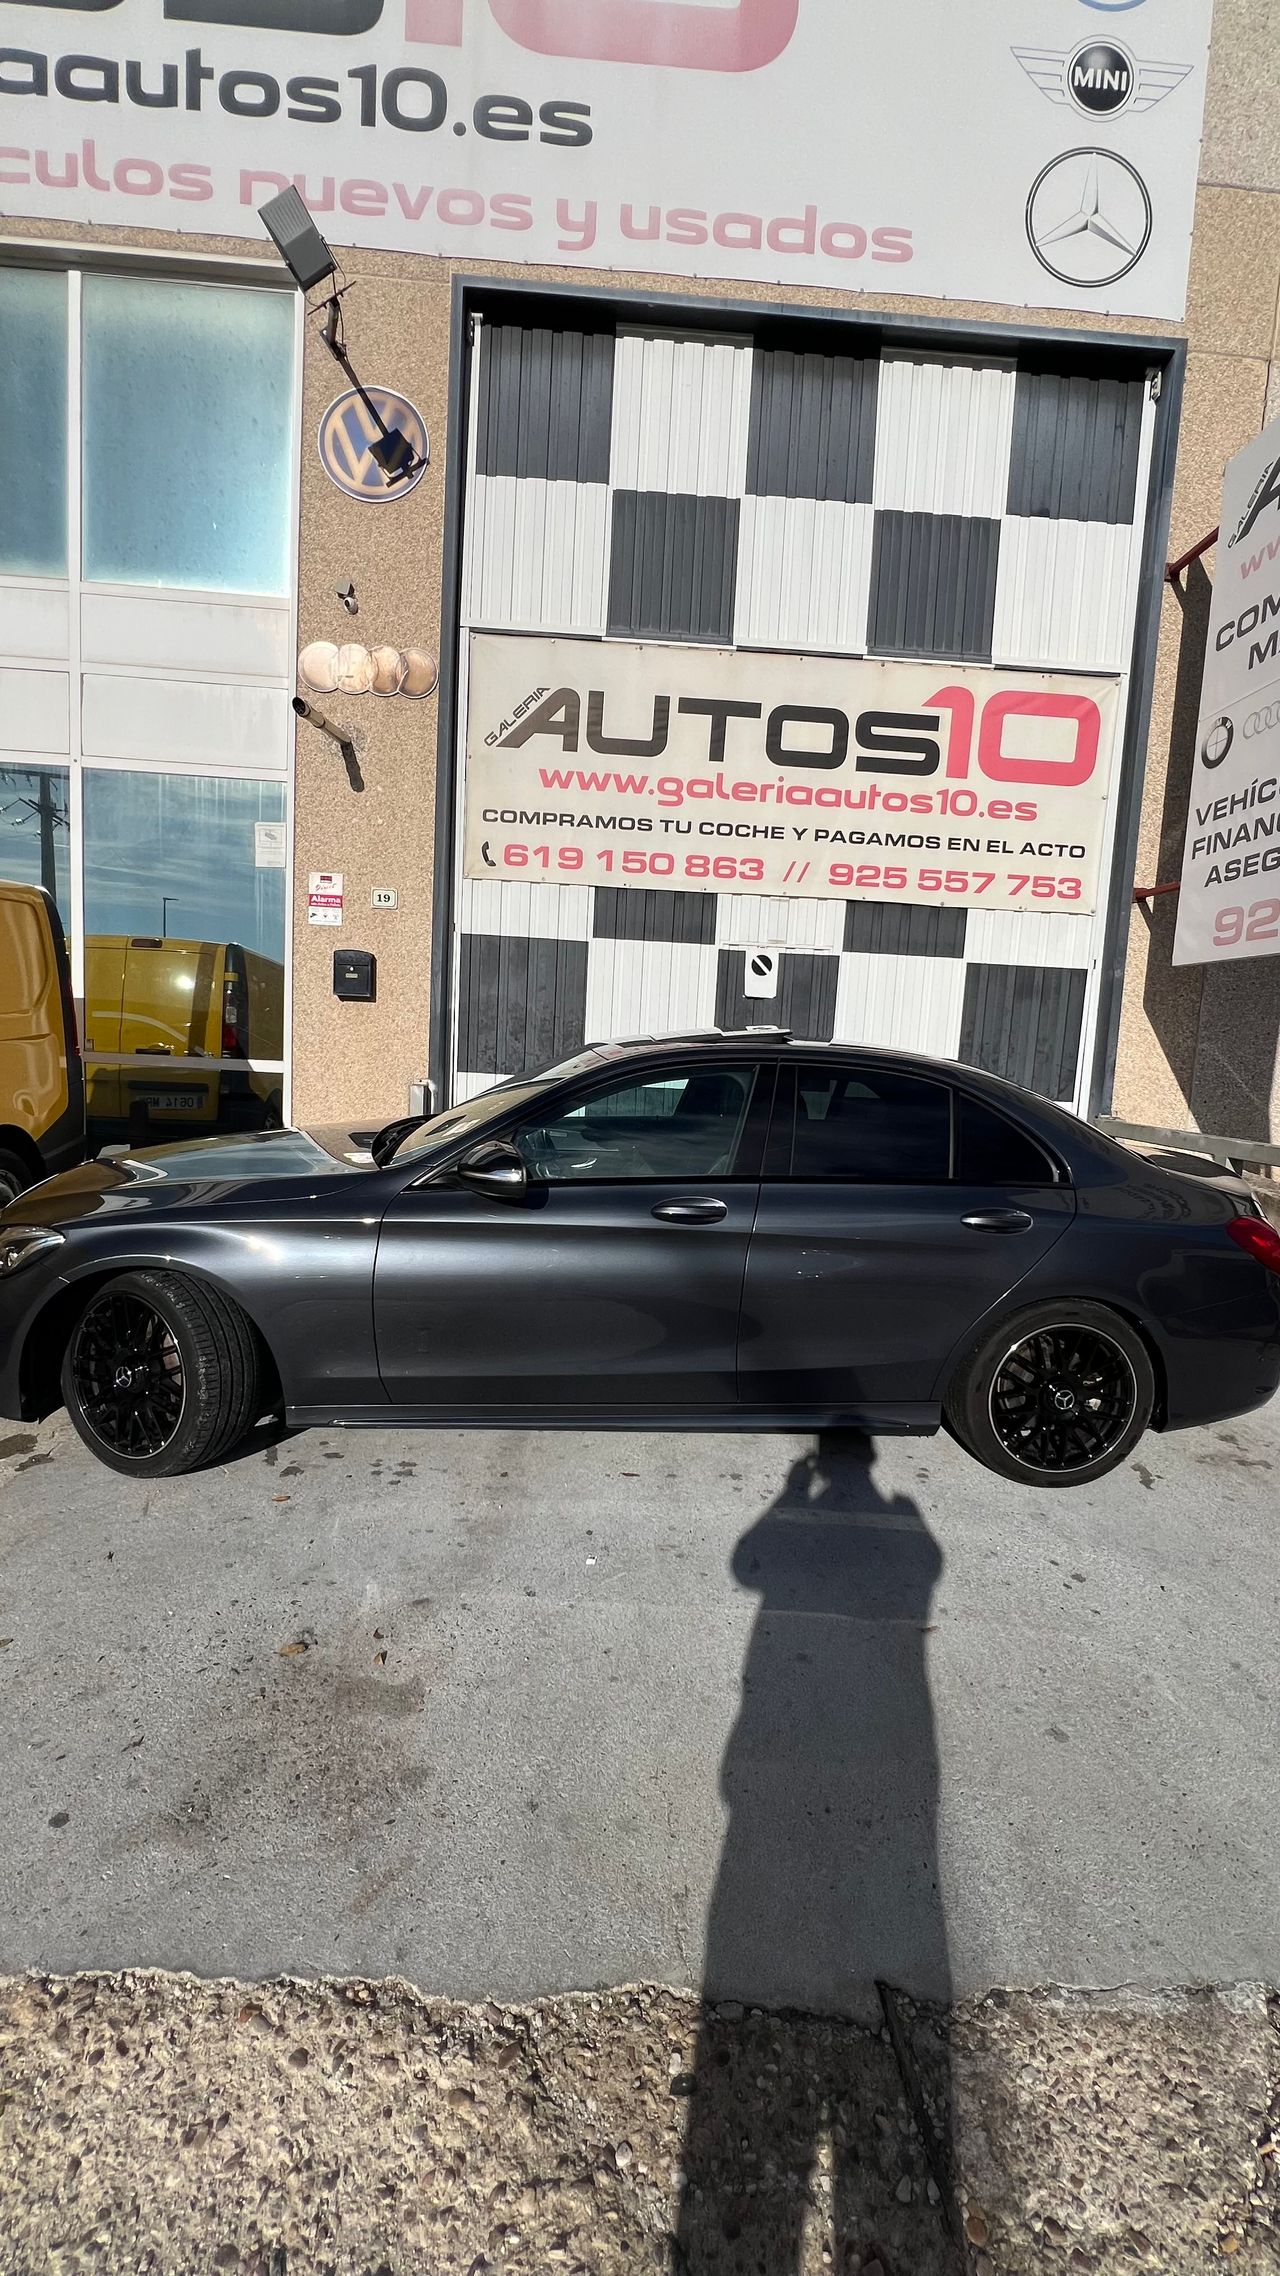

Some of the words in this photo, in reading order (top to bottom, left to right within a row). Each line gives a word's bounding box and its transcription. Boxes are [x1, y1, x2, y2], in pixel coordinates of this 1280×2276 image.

[1074, 66, 1127, 92] MINI
[239, 169, 533, 231] nuevos
[556, 199, 597, 252] y
[619, 203, 914, 263] usados
[1227, 461, 1275, 549] GALERIA
[1248, 630, 1280, 670] M
[484, 687, 551, 747] GALERIA
[538, 768, 1038, 821] www.galeriaautos10.es
[1196, 778, 1280, 826] VEHÍC
[482, 809, 653, 831] COMPRAMOS
[659, 819, 692, 834] TU
[699, 821, 785, 840] COCHE
[792, 827, 808, 840] Y
[814, 829, 941, 850] PAGAMOS
[947, 838, 980, 852] EN
[986, 840, 1014, 854] EL
[1019, 842, 1086, 859] ACTO
[1192, 813, 1280, 860] FINAN
[503, 843, 584, 871] 619
[596, 849, 675, 876] 150
[684, 854, 765, 881] 863
[828, 863, 908, 890] 925
[917, 868, 996, 895] 557
[1007, 874, 1083, 901] 753
[311, 895, 341, 904] Alarma
[377, 894, 391, 903] 19
[1212, 898, 1280, 947] 92
